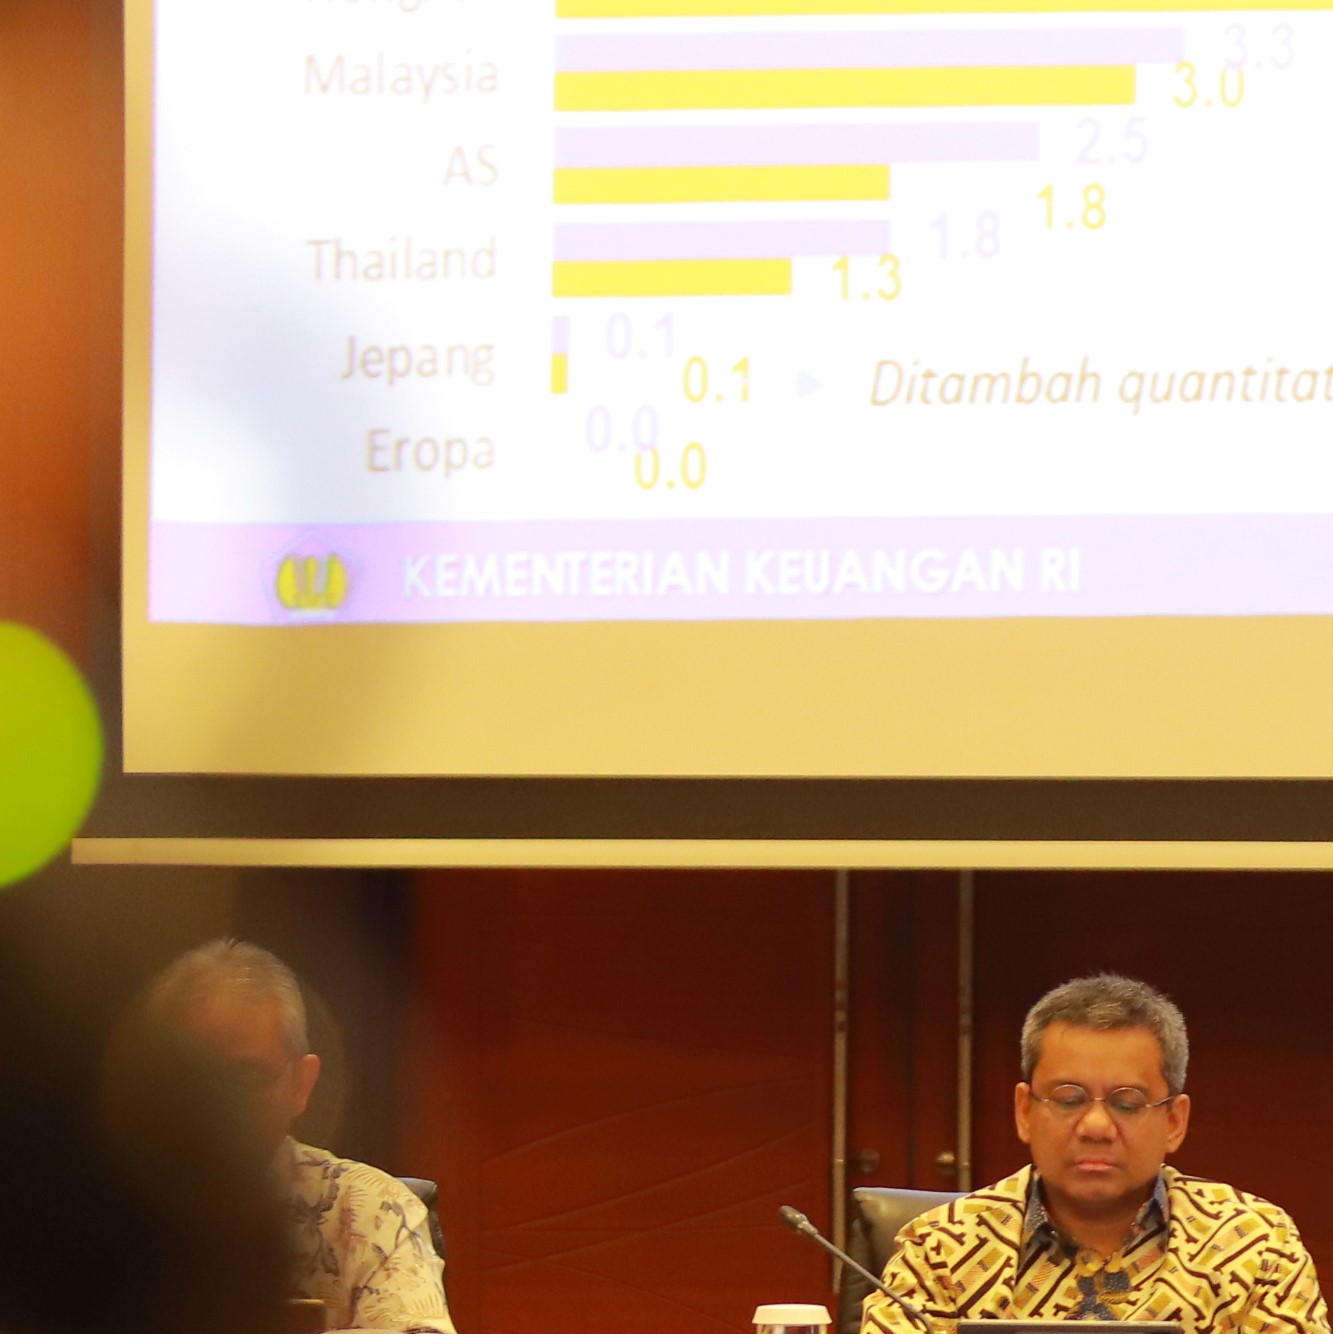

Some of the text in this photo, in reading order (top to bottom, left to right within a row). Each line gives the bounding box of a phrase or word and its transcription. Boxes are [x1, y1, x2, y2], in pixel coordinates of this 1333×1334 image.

[1223, 21, 1296, 70] 3.3
[303, 48, 499, 105] Malaysia
[1172, 59, 1246, 110] 3.0
[442, 144, 499, 187] AS
[1074, 115, 1149, 166] 2.5
[1036, 181, 1108, 232] 1.8
[304, 236, 497, 283] Thailand
[929, 209, 1002, 260] 1.8
[831, 251, 903, 303] 1.3
[339, 334, 496, 388] Jepang
[604, 311, 674, 361] 0.1
[681, 354, 751, 404] 0.1
[868, 355, 1102, 408] Ditambah
[364, 427, 495, 479] Eropa
[585, 403, 660, 455] 0.0
[632, 440, 708, 492] 0.0
[403, 548, 1081, 597] KEMENTERIAN KEUANGAN RI
